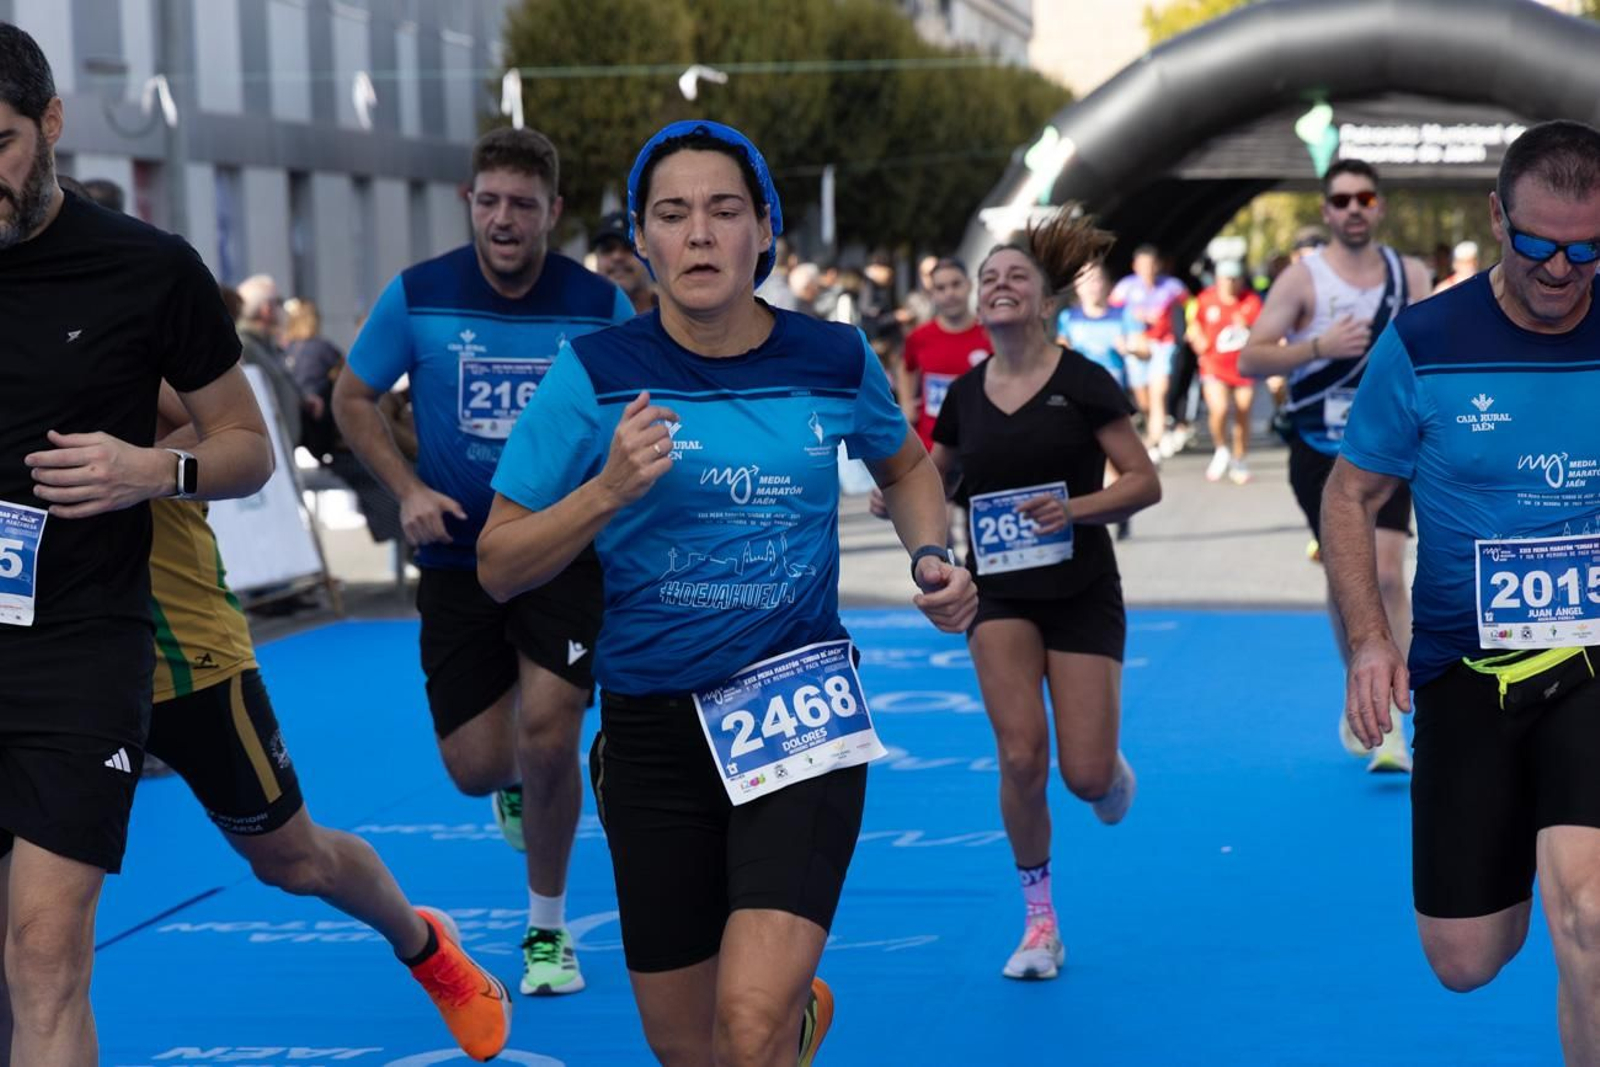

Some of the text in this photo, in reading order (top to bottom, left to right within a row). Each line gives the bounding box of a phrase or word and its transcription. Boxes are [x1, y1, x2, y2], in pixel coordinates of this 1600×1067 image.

[1480, 413, 1511, 422] RURAL
[672, 441, 703, 449] URAL
[1569, 460, 1596, 468] MEDIA
[759, 476, 791, 484] MEDIA
[1565, 479, 1586, 488] JAÉN
[756, 486, 803, 495] MARATÓN
[752, 497, 777, 505] JAÉN
[1528, 607, 1584, 618] JUAN ÁNGEL
[721, 675, 857, 758] 2468
[782, 727, 827, 751] DOLORES
[151, 1045, 384, 1062] JAÉN
